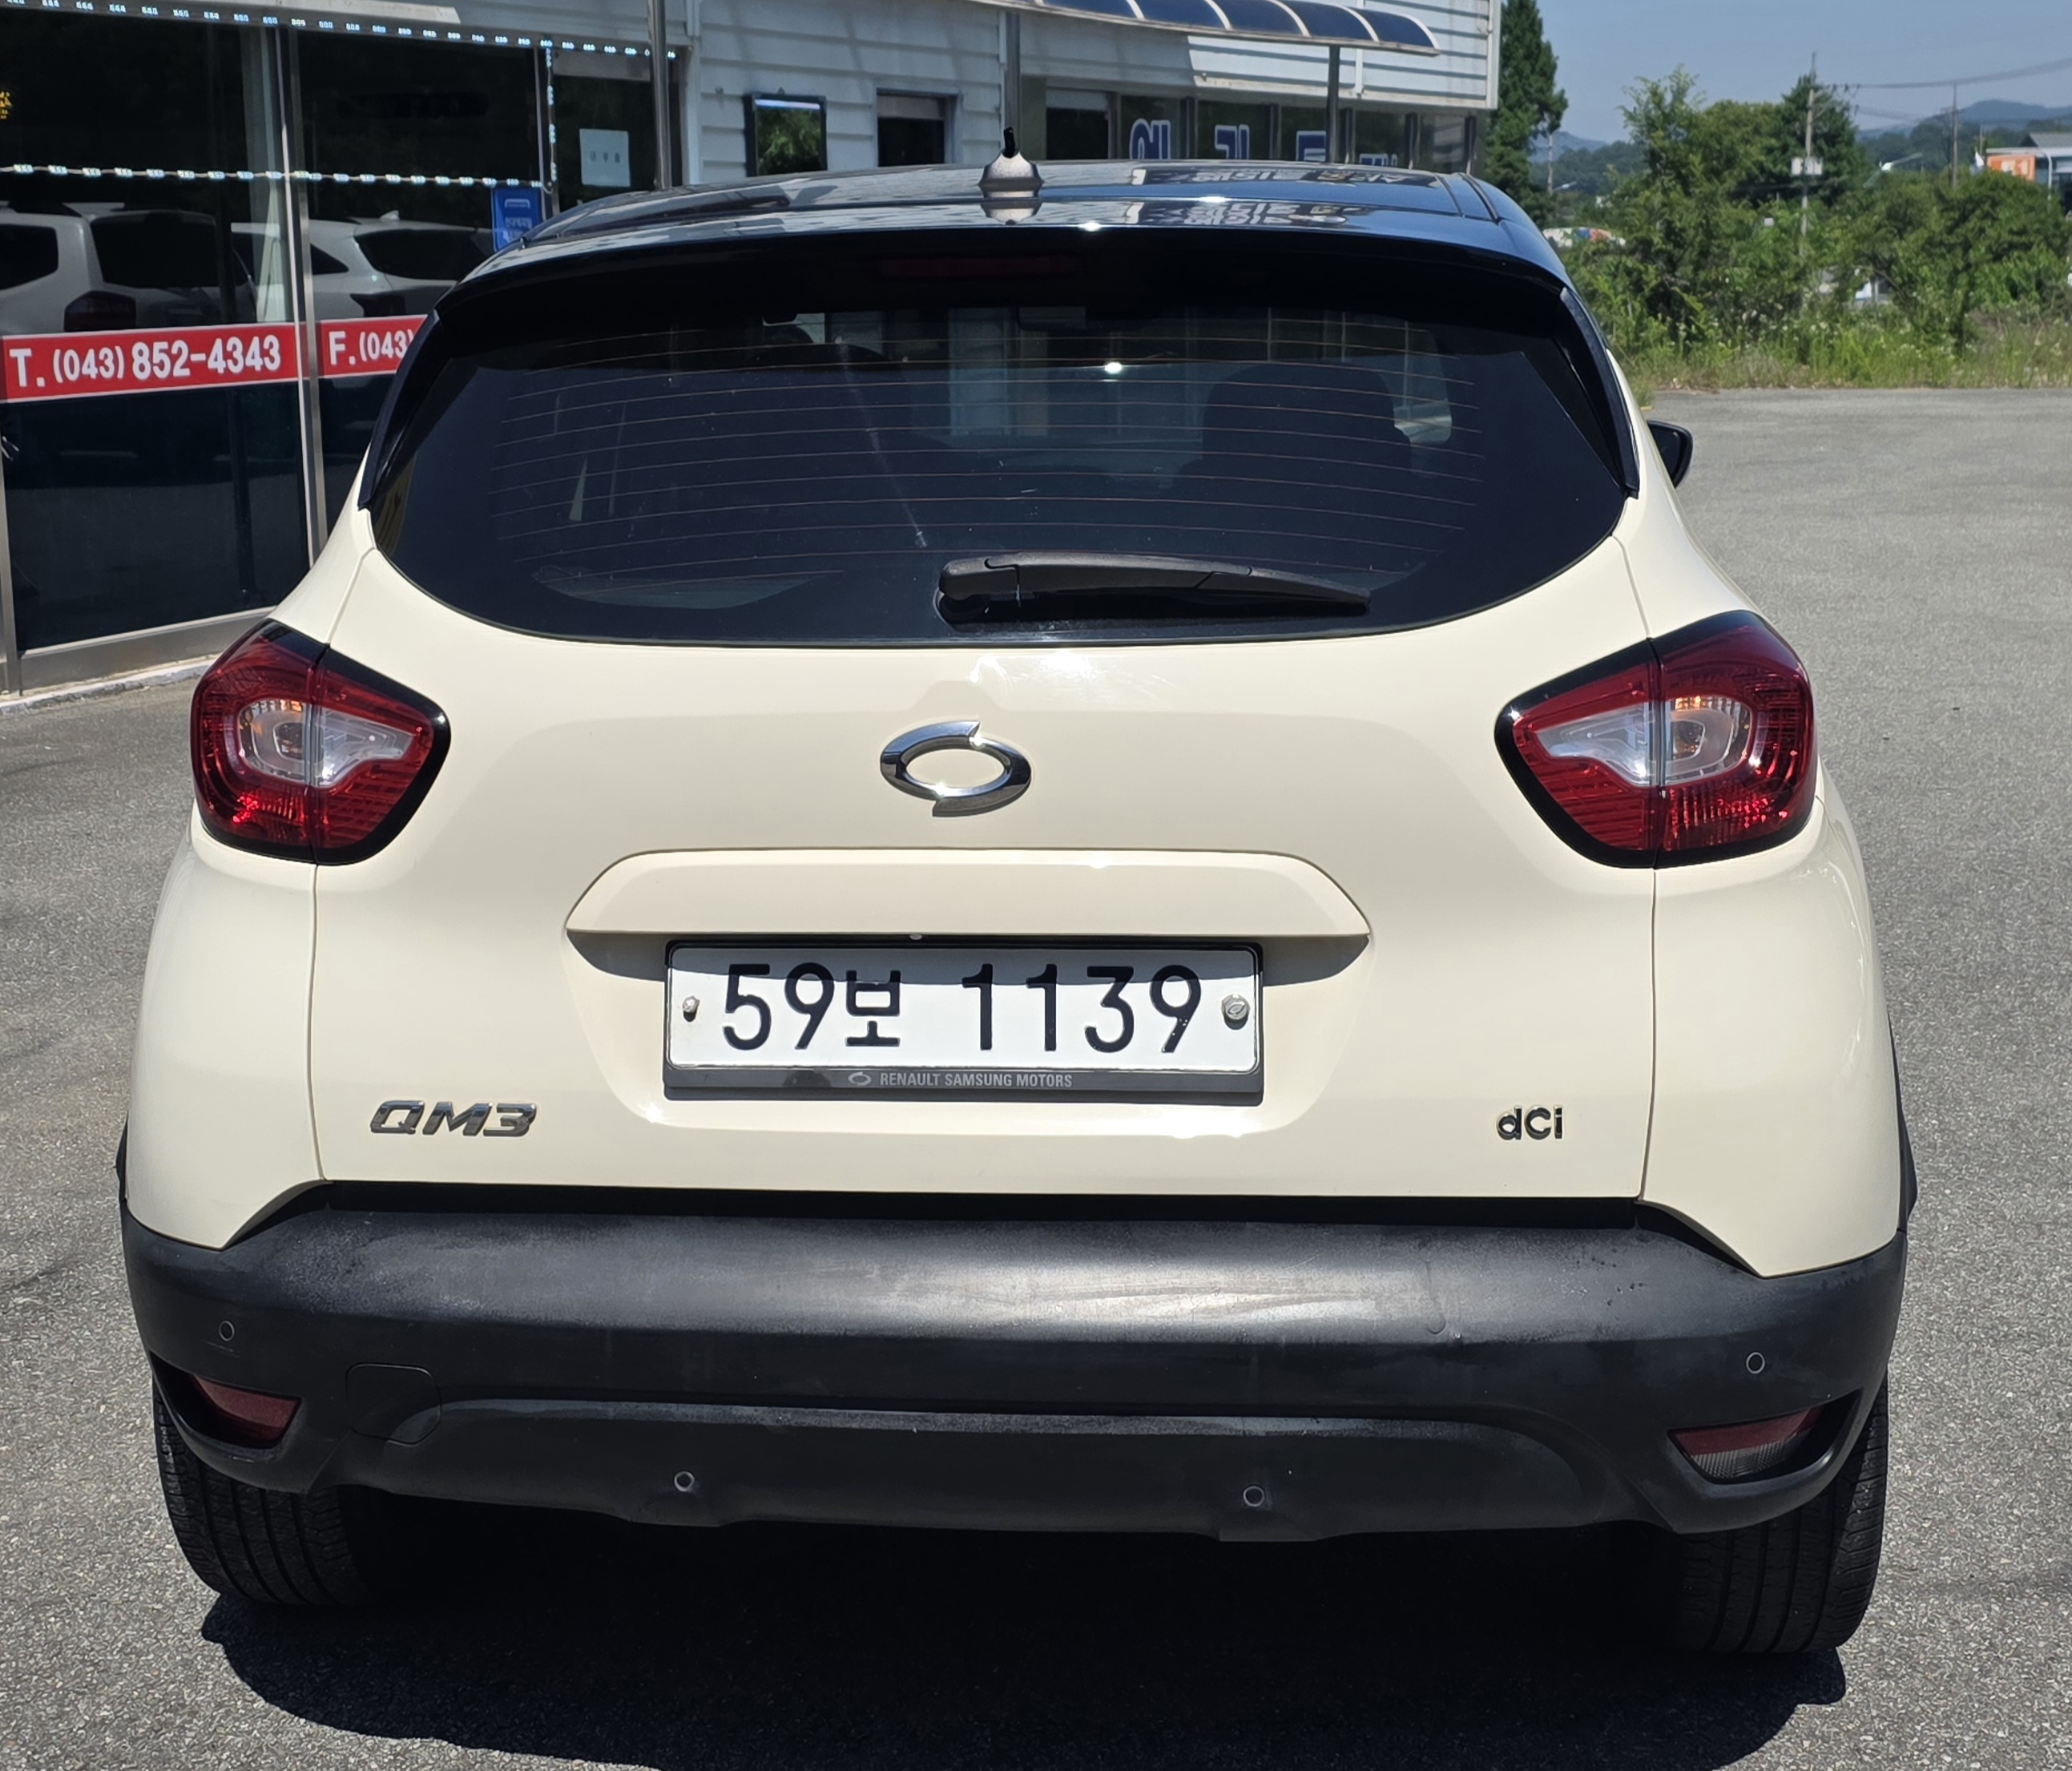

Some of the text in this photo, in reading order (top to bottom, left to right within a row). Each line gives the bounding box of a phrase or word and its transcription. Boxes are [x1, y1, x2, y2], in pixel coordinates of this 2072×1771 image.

[53, 345, 124, 383] (043)
[131, 334, 281, 381] 852-4343
[722, 962, 1201, 1053] 59보 1139
[880, 1072, 1073, 1087] RENAULT SAMSUNG MOTORS
[369, 1100, 537, 1137] QM3
[1496, 1106, 1562, 1140] dCi
